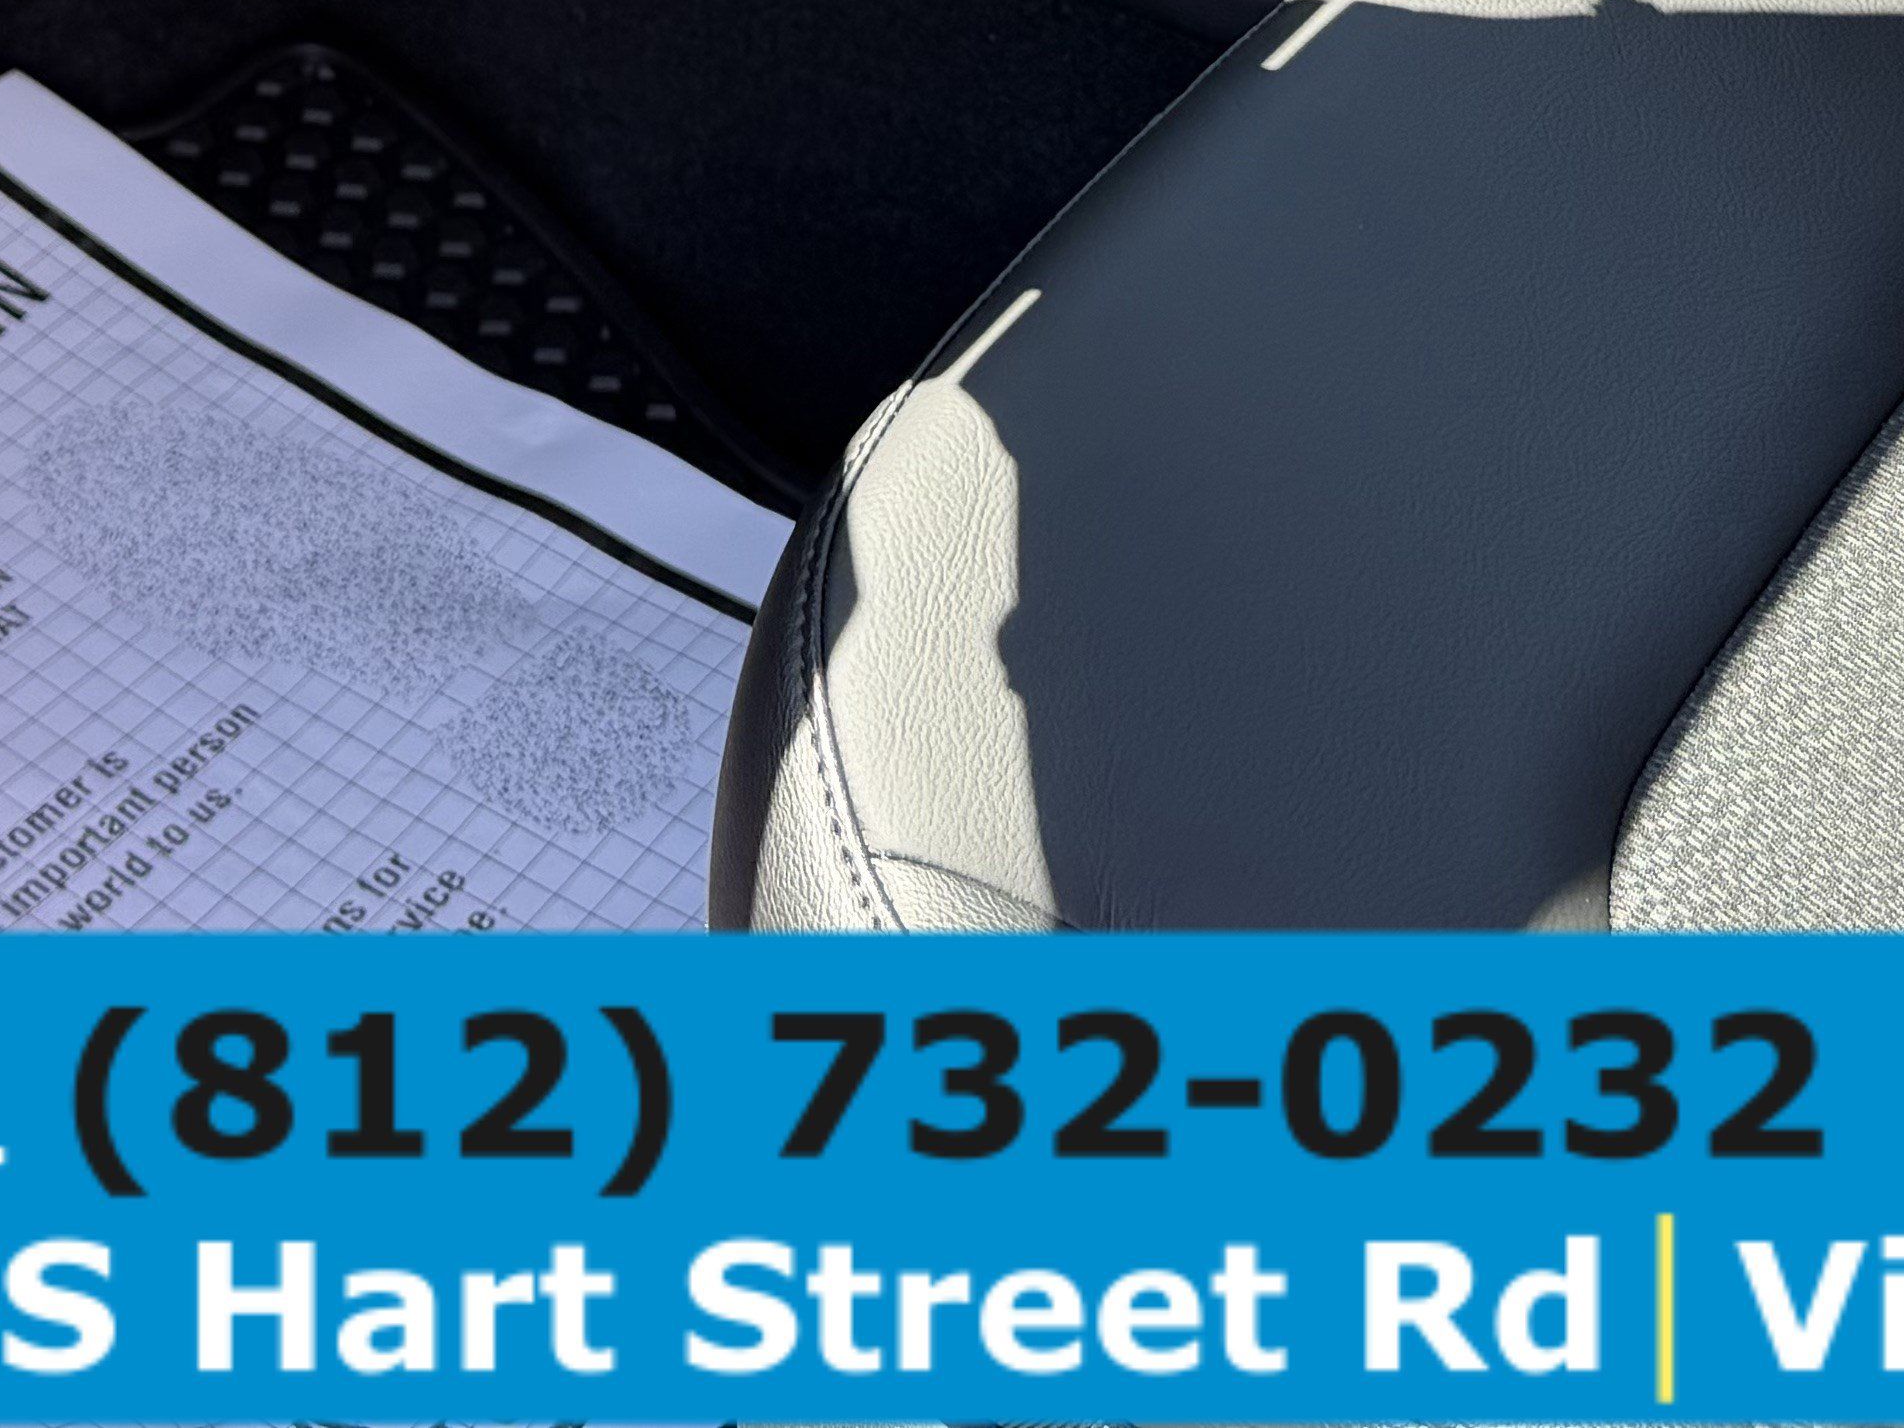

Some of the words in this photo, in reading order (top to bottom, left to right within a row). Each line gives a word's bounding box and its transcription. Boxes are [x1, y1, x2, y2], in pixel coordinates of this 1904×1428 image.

[86, 750, 131, 780] is
[152, 702, 263, 796] person
[57, 849, 155, 933] world
[146, 821, 191, 857] to
[356, 851, 411, 898] for
